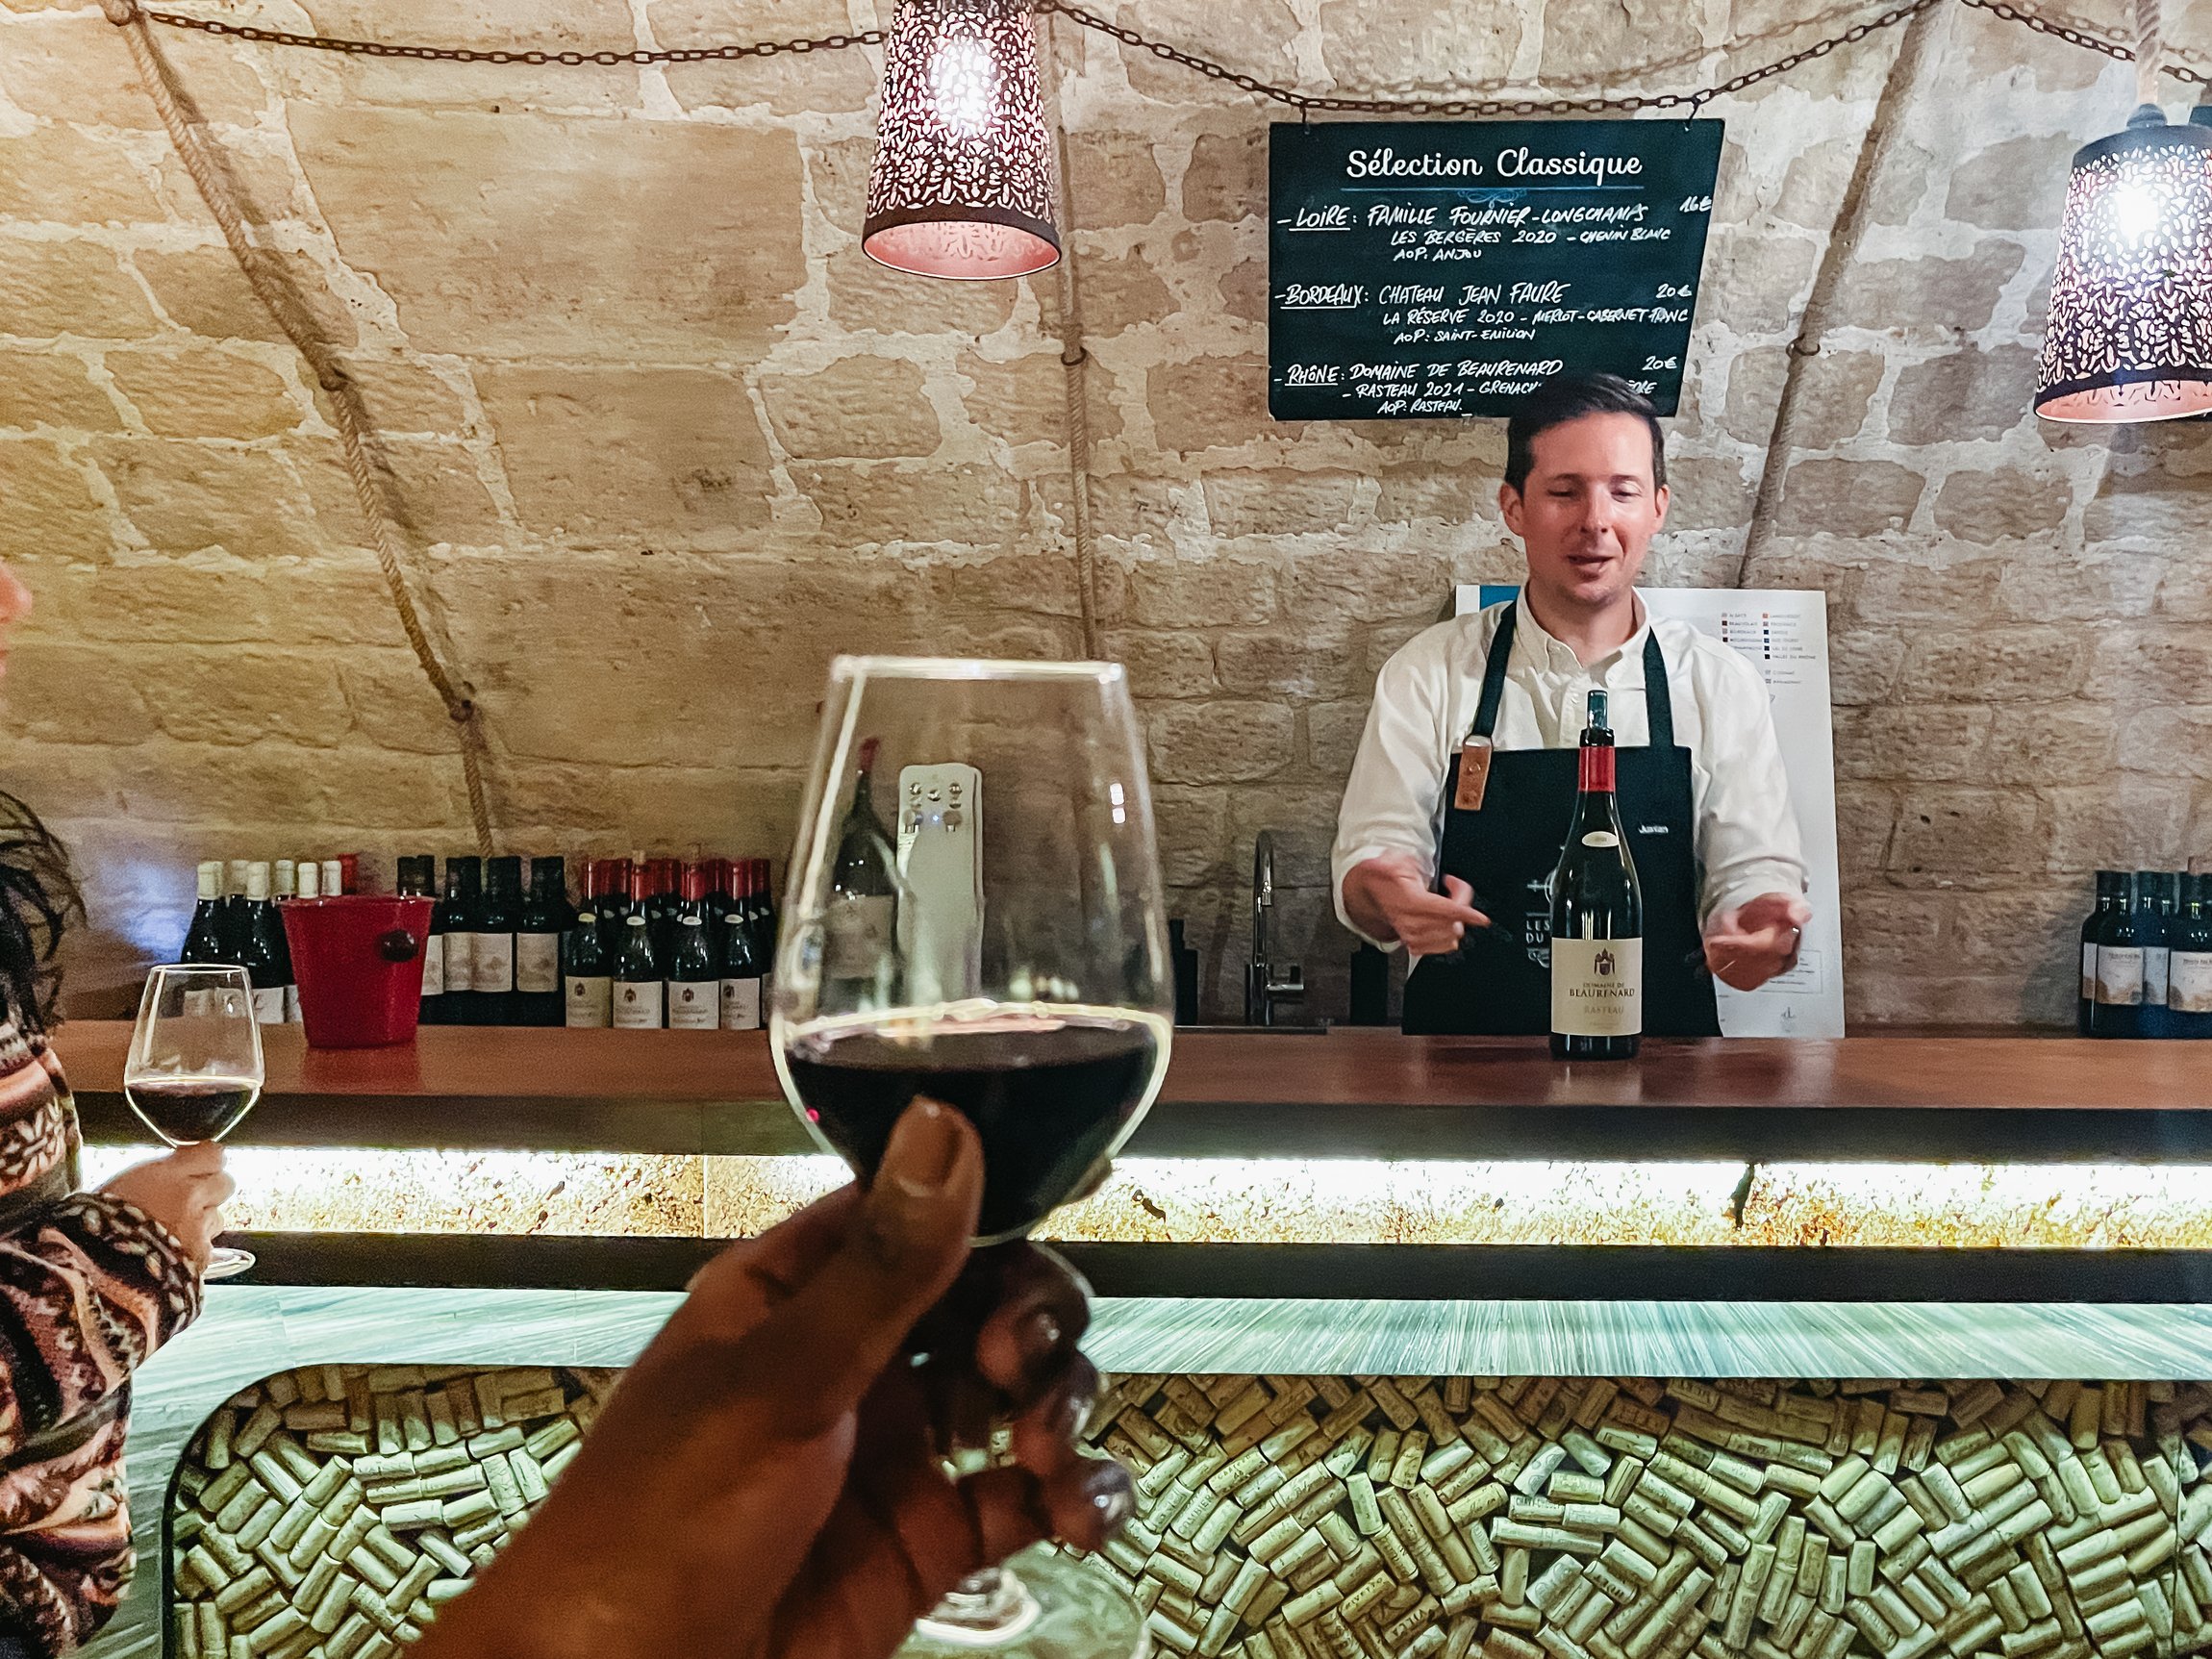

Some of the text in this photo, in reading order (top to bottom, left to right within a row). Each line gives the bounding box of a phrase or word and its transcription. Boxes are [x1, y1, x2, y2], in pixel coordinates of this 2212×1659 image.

[1346, 146, 1643, 187] Sélection Classique
[1367, 202, 1438, 227] FAMILLE
[1391, 230, 1418, 245] LES
[1512, 229, 1557, 244] 2020
[1630, 227, 1672, 241] BLANC
[1432, 247, 1482, 263] ANJOU
[1378, 285, 1445, 305] CHATEAU
[1458, 285, 1501, 306] JEAN
[1509, 280, 1571, 304] FAURE
[1382, 313, 1400, 326] LA
[1406, 307, 1470, 326] RÉSERVE
[1477, 309, 1515, 325] 2020
[1349, 360, 1420, 381] DOMAINE
[1426, 363, 1452, 378] DE
[1457, 359, 1564, 378] BEAURENARD
[1355, 382, 1419, 399] RASTEAU
[1423, 381, 1465, 397] 2021
[1570, 988, 1635, 998] BEAURENARD
